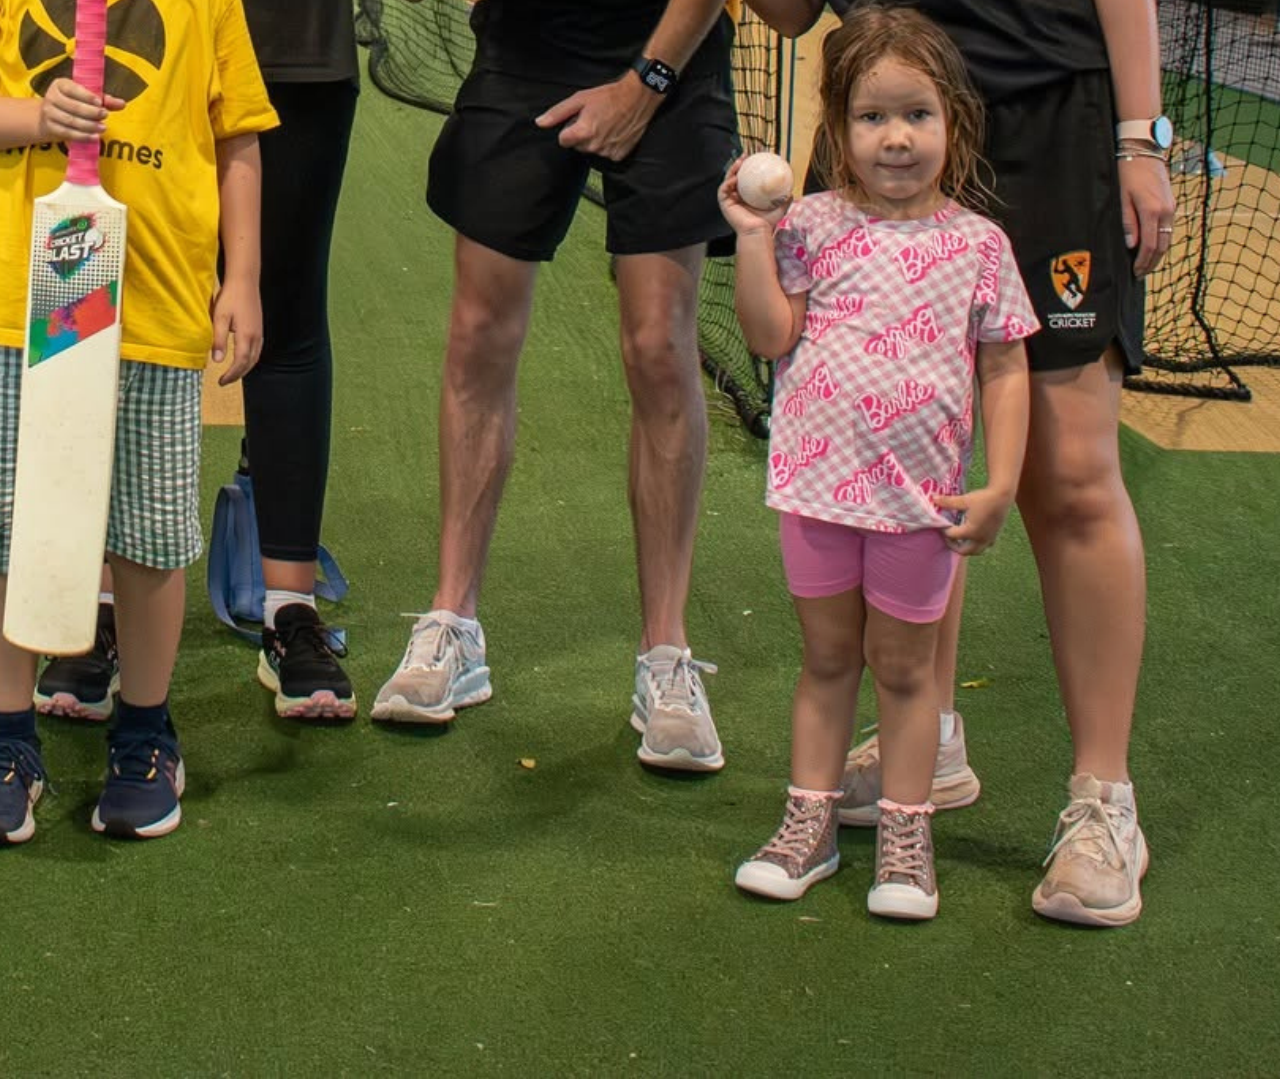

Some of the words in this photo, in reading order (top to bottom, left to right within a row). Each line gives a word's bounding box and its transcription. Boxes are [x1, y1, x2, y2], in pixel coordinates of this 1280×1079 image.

[895, 231, 968, 283] Barbie
[865, 305, 945, 358] Barbie
[1048, 318, 1096, 329] CRICKET
[855, 379, 937, 433] Barbie
